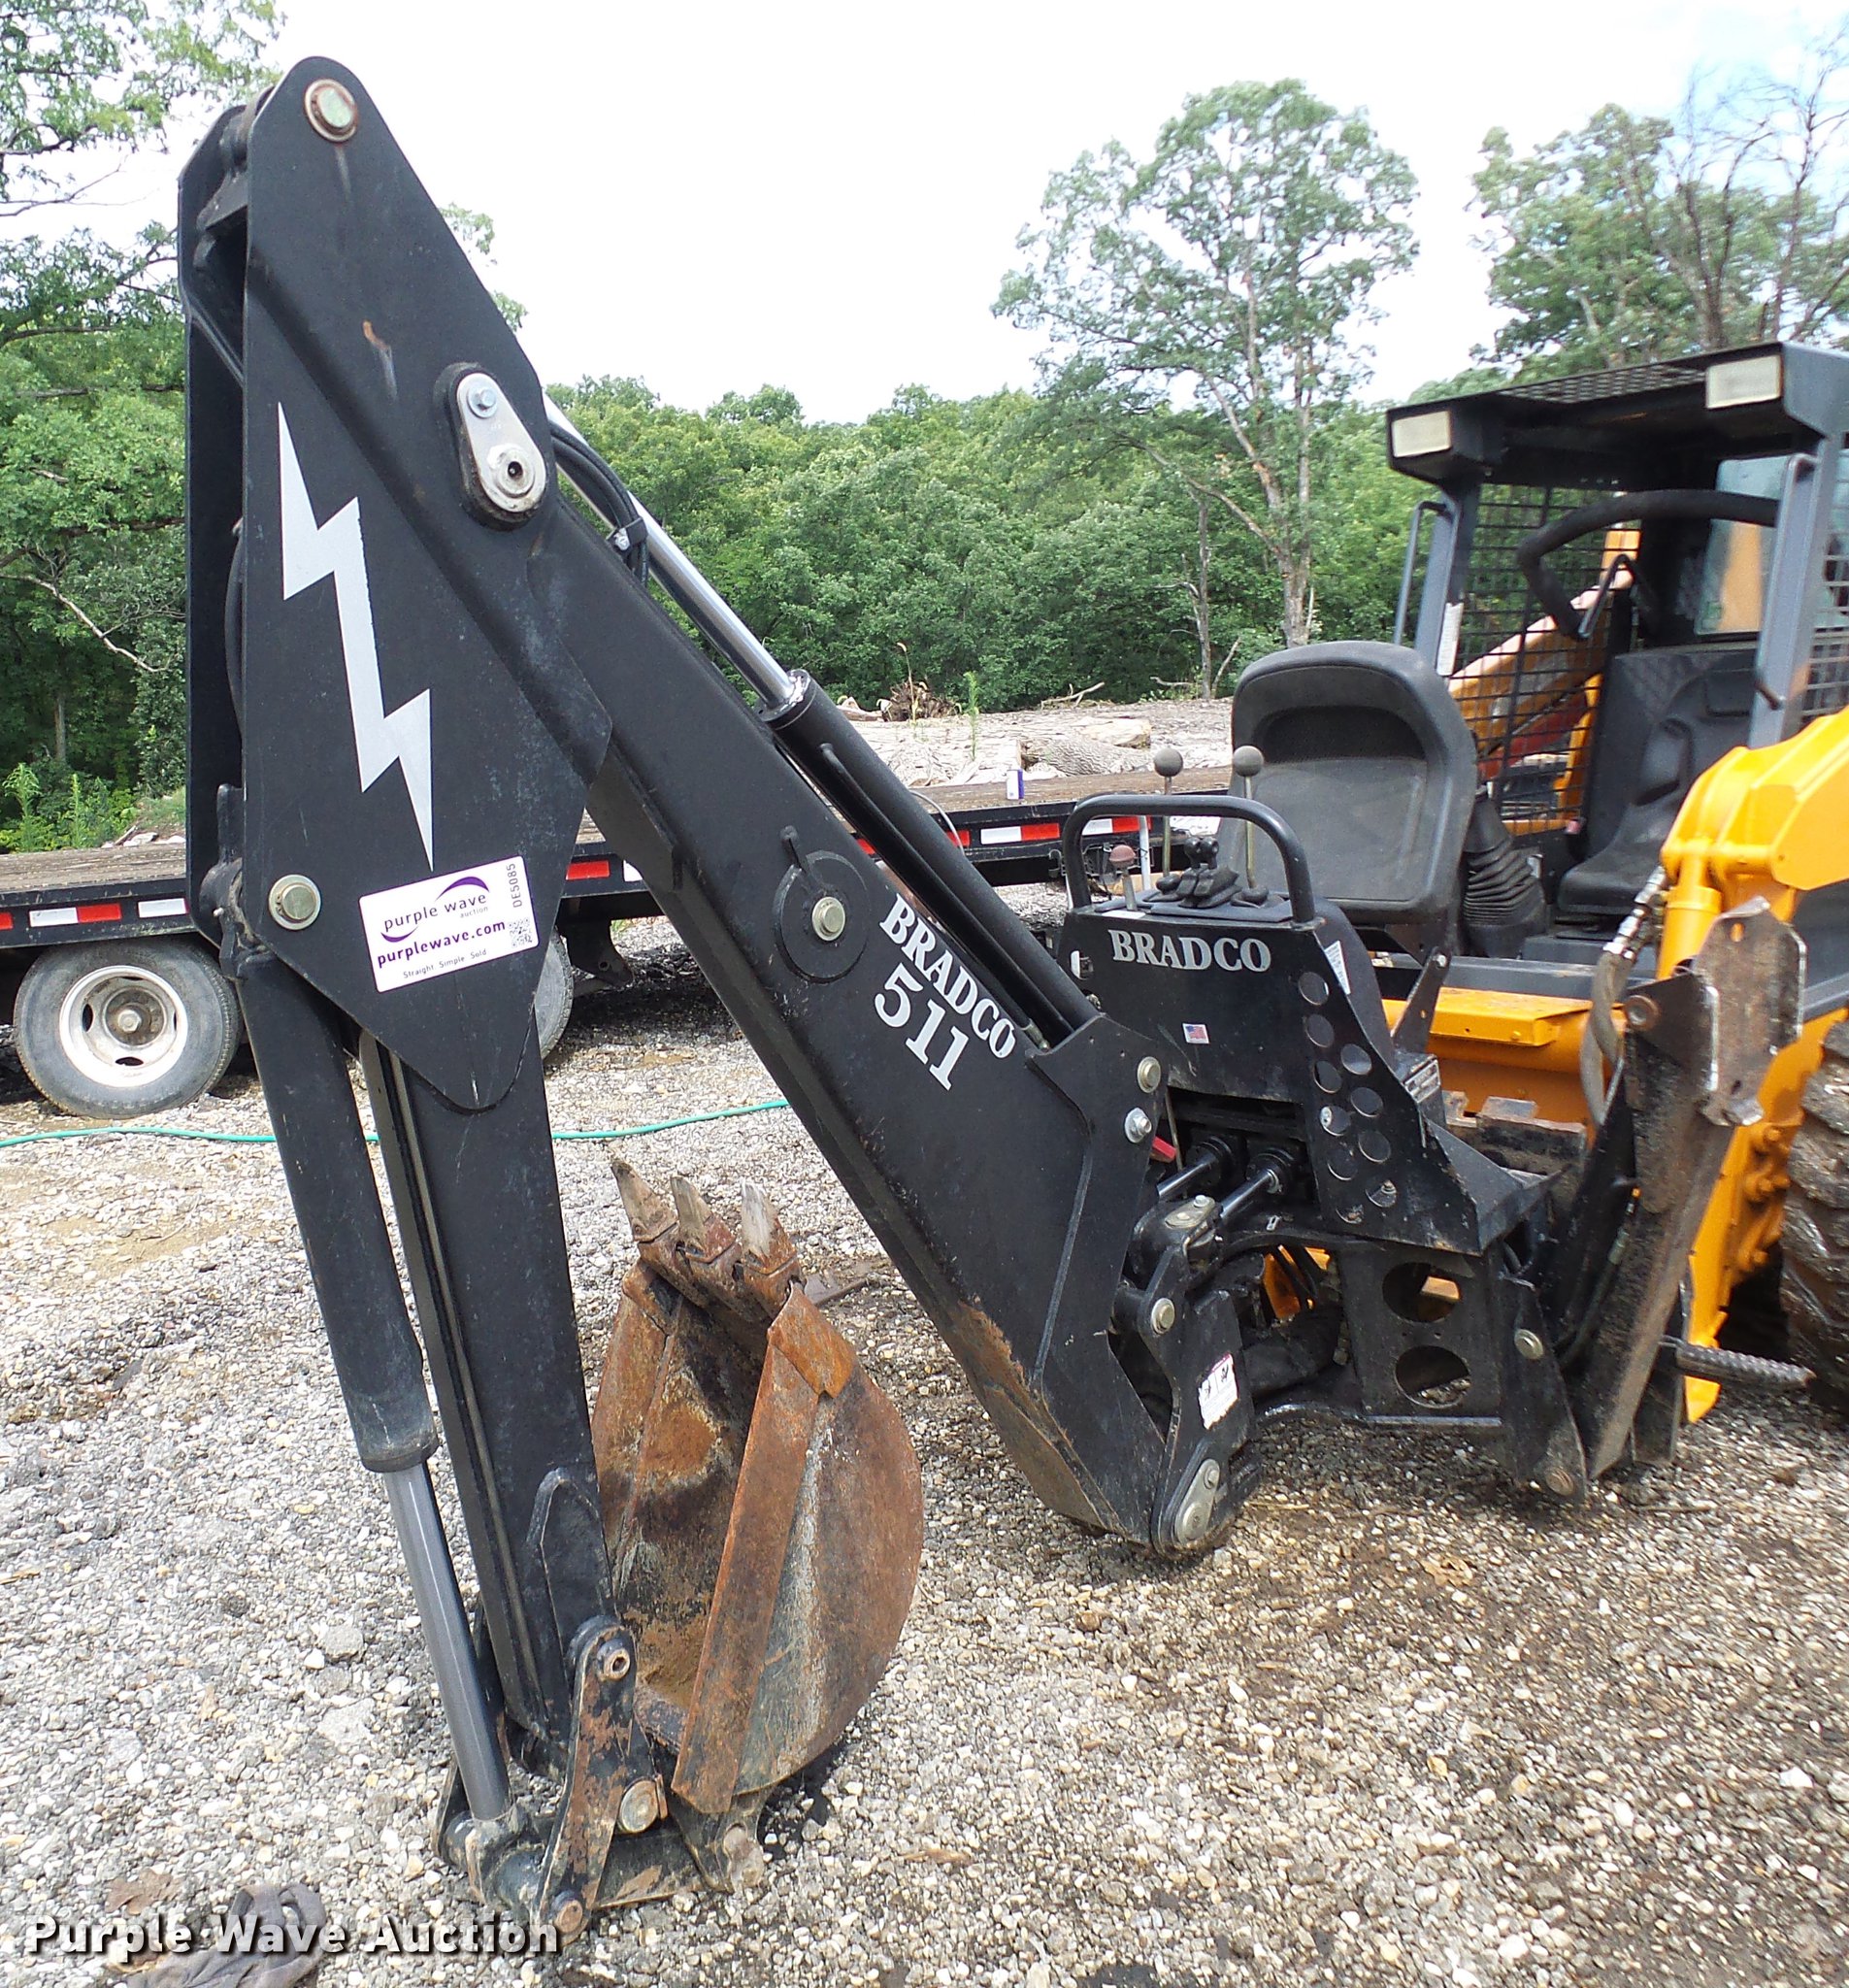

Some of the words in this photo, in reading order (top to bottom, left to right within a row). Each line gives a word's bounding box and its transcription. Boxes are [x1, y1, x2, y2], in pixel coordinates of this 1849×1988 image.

[506, 863, 523, 908] DE5085
[384, 906, 438, 932] purple
[444, 894, 486, 913] wave
[460, 906, 488, 918] auction
[378, 921, 506, 969] purplewave.com
[1107, 929, 1271, 973] BRADCO
[878, 892, 1016, 1059] BRADCO
[875, 962, 970, 1091] 511
